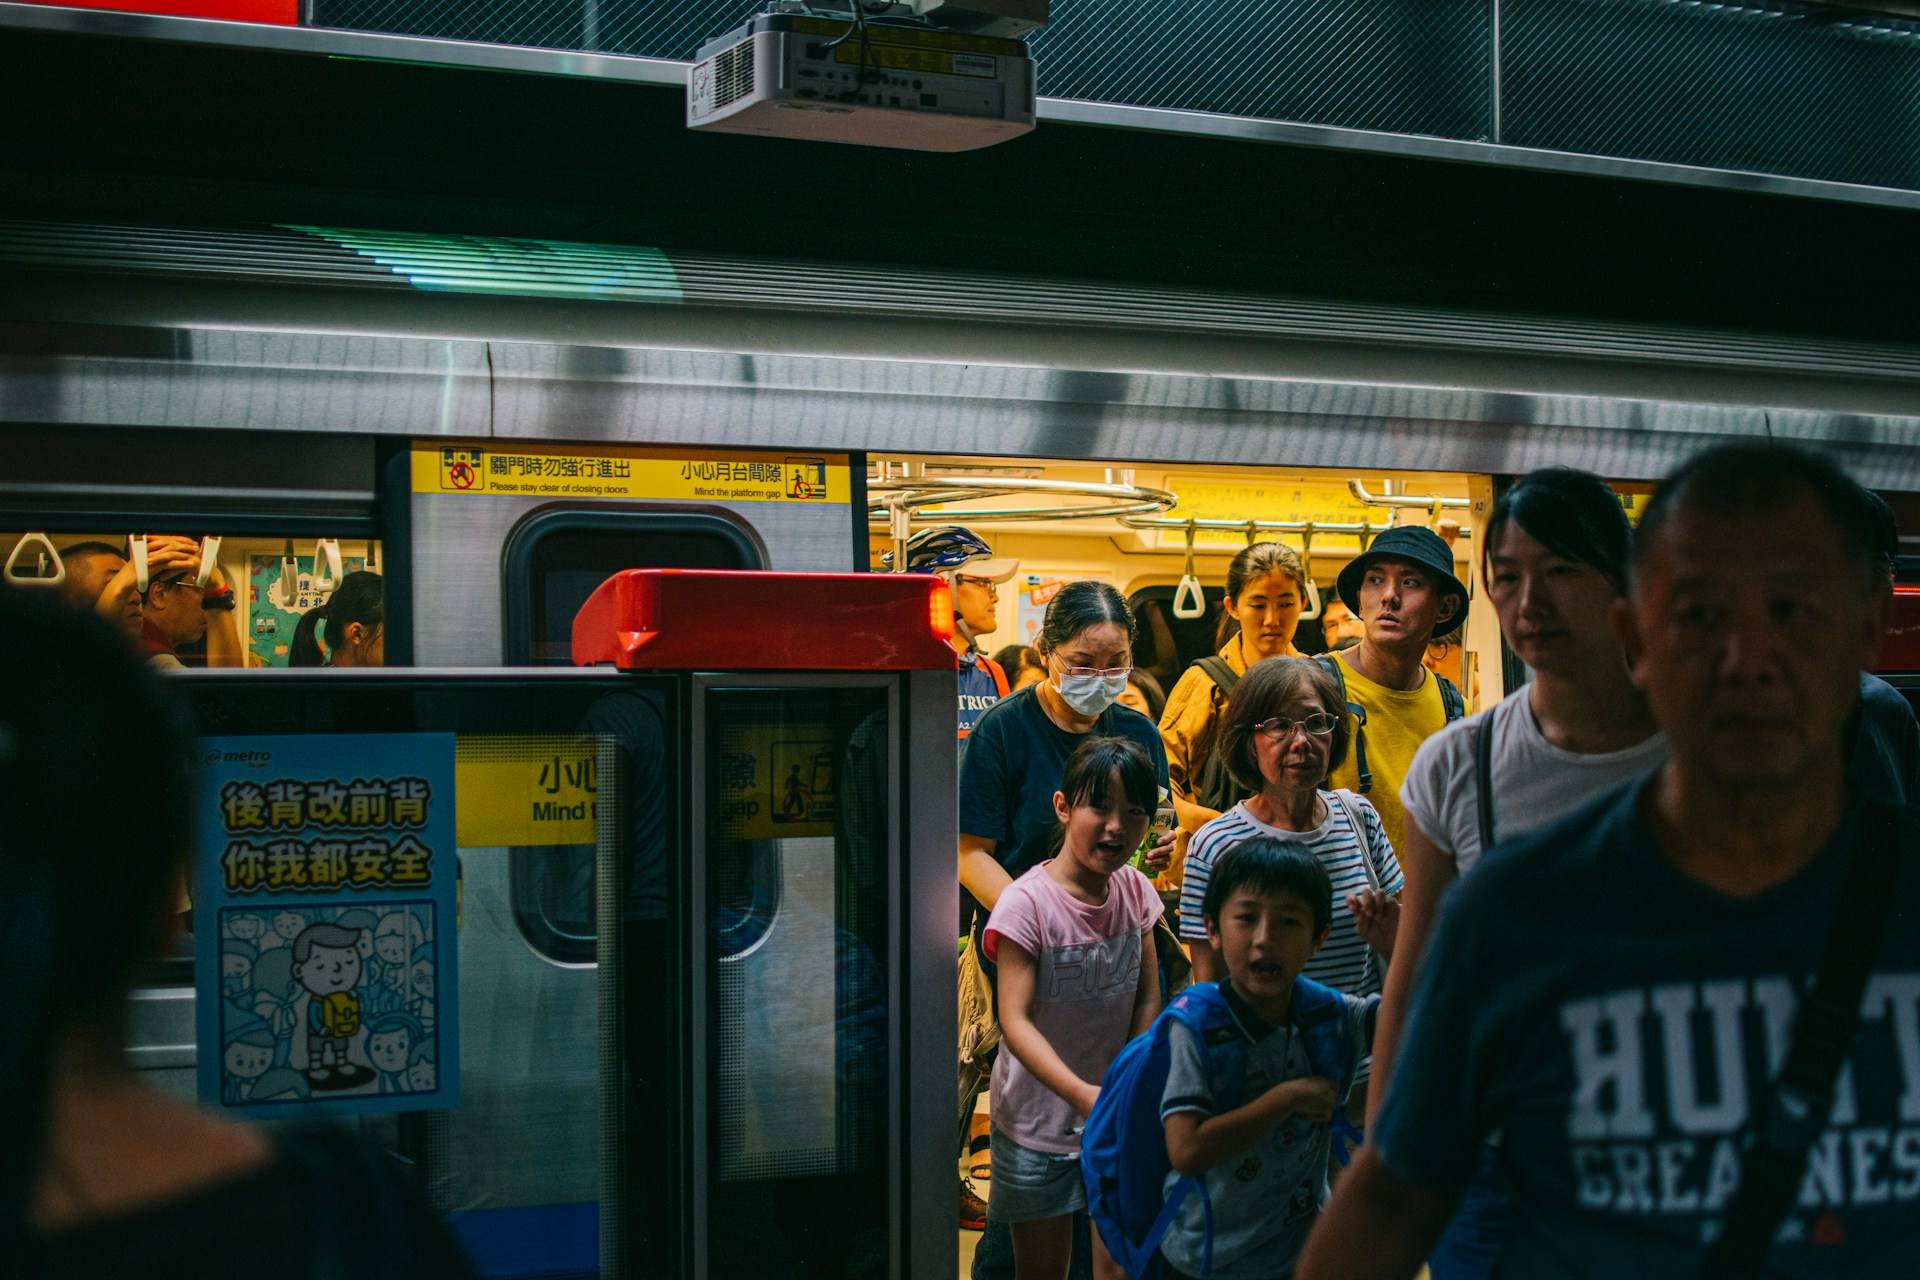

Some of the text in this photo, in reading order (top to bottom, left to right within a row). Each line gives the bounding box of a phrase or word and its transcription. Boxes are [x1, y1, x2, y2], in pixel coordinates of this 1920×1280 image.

[489, 455, 631, 479] 關門時勿強行進出
[681, 461, 782, 483] 小心月台間隙
[490, 482, 629, 494] Please stay clear of closing doors
[694, 487, 781, 499] Mind the platform gap
[223, 780, 430, 831] 後背改前背
[533, 801, 585, 821] Mind
[223, 838, 432, 889] 你我都安全
